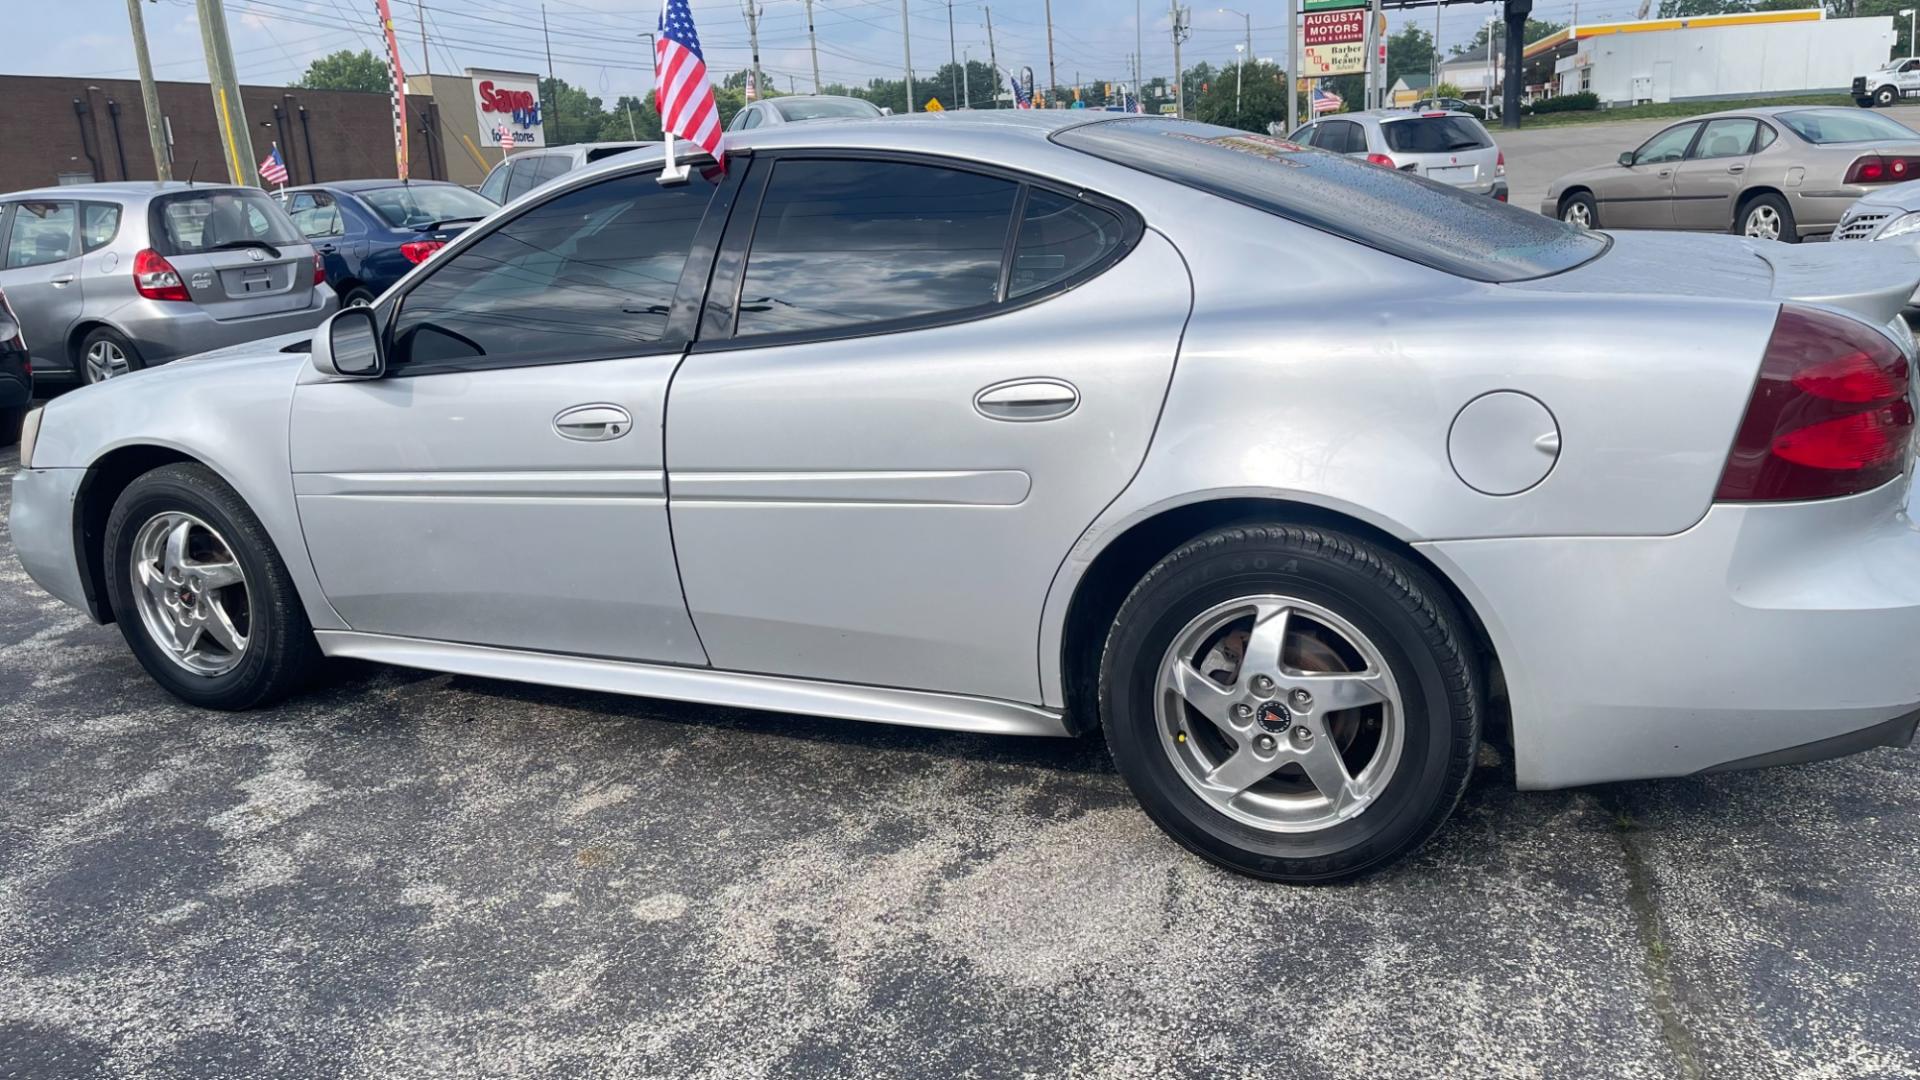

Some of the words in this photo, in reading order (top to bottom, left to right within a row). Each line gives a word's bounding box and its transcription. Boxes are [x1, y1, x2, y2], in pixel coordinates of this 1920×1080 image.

[1307, 12, 1362, 25] AUGUSTA
[1310, 24, 1359, 35] MOTORS
[1334, 33, 1362, 41] LEASING
[1331, 45, 1361, 54] Barber
[1331, 56, 1361, 65] Beauty
[479, 81, 533, 114] Save
